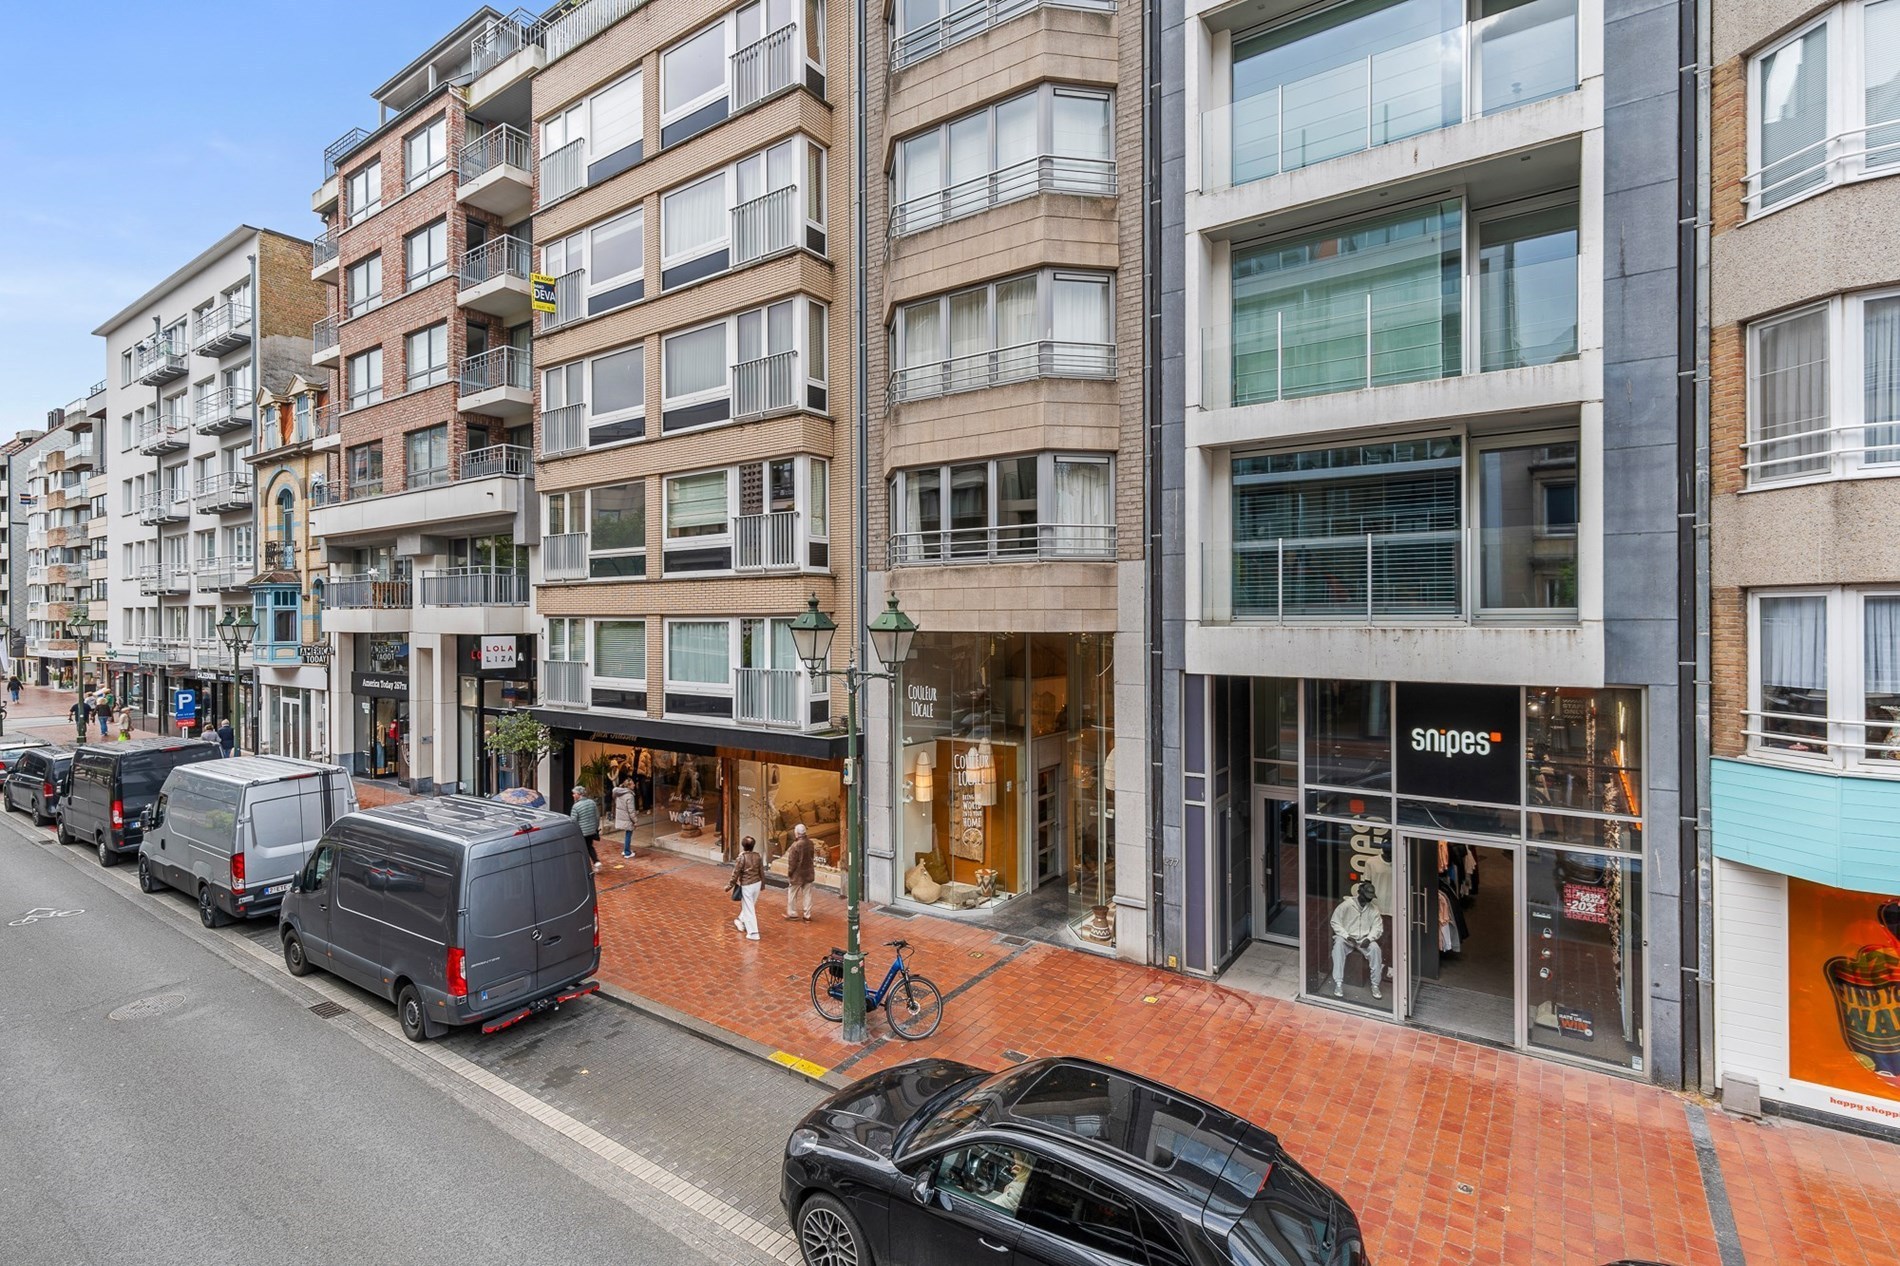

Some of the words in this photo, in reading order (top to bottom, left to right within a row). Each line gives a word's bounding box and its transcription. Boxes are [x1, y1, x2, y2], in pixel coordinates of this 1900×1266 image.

[534, 289, 556, 301] DEVA
[300, 646, 335, 656] AMERICA
[306, 655, 327, 663] TODAY
[486, 655, 514, 663] LIZA
[362, 679, 380, 688] America
[380, 680, 394, 691] Today
[178, 693, 193, 710] P
[1411, 728, 1491, 758] snipes
[1830, 1096, 1863, 1111] happy
